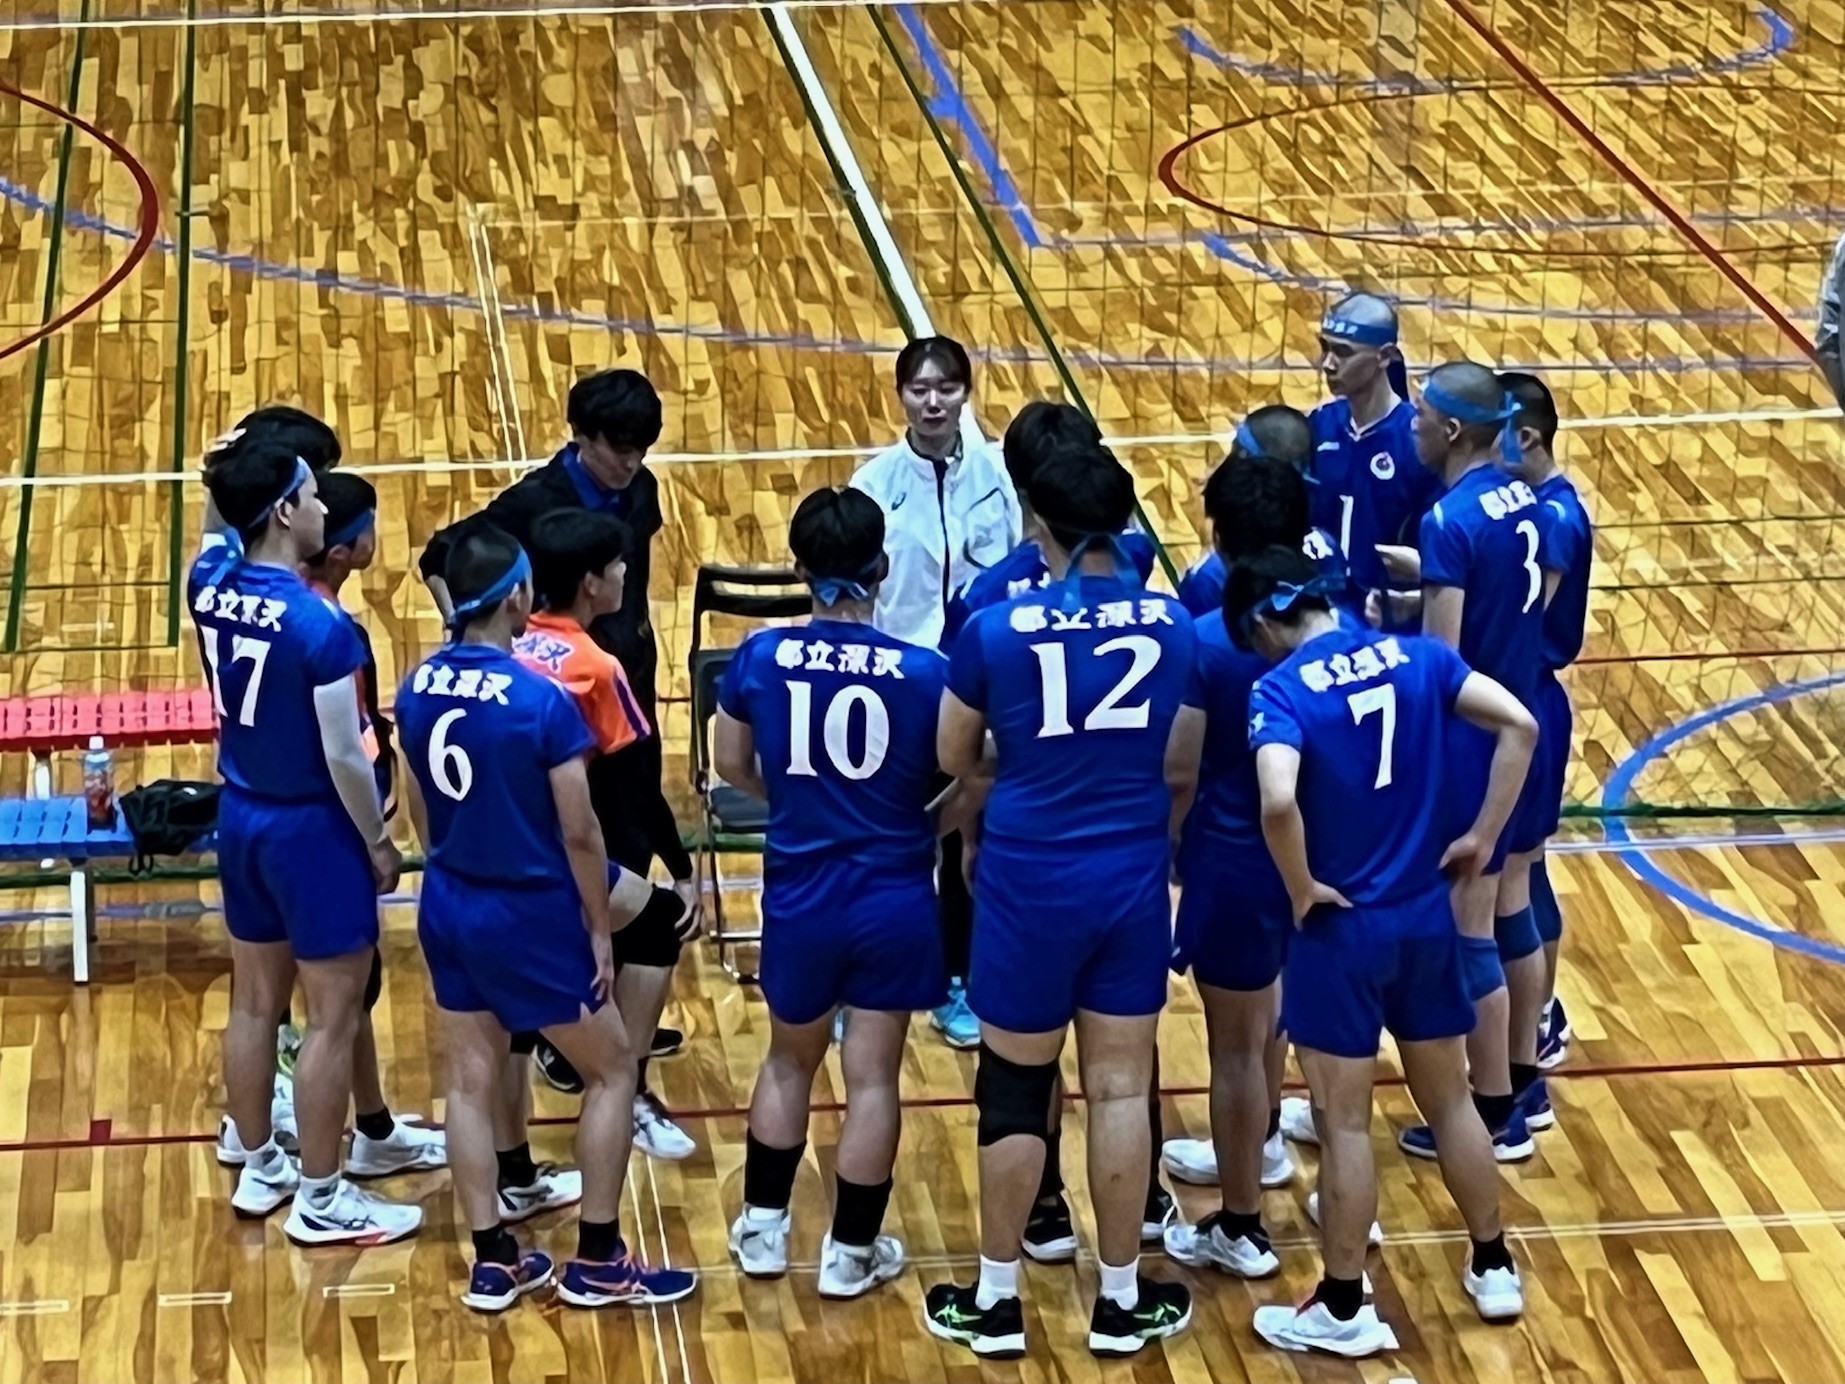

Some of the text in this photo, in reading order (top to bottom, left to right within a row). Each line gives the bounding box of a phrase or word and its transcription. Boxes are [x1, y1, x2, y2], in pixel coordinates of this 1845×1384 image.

[1516, 519, 1542, 613] 3
[200, 624, 272, 727] 17
[1029, 635, 1162, 738] 12
[428, 708, 473, 801] 6
[785, 680, 889, 780] 10
[1347, 683, 1396, 790] 7
